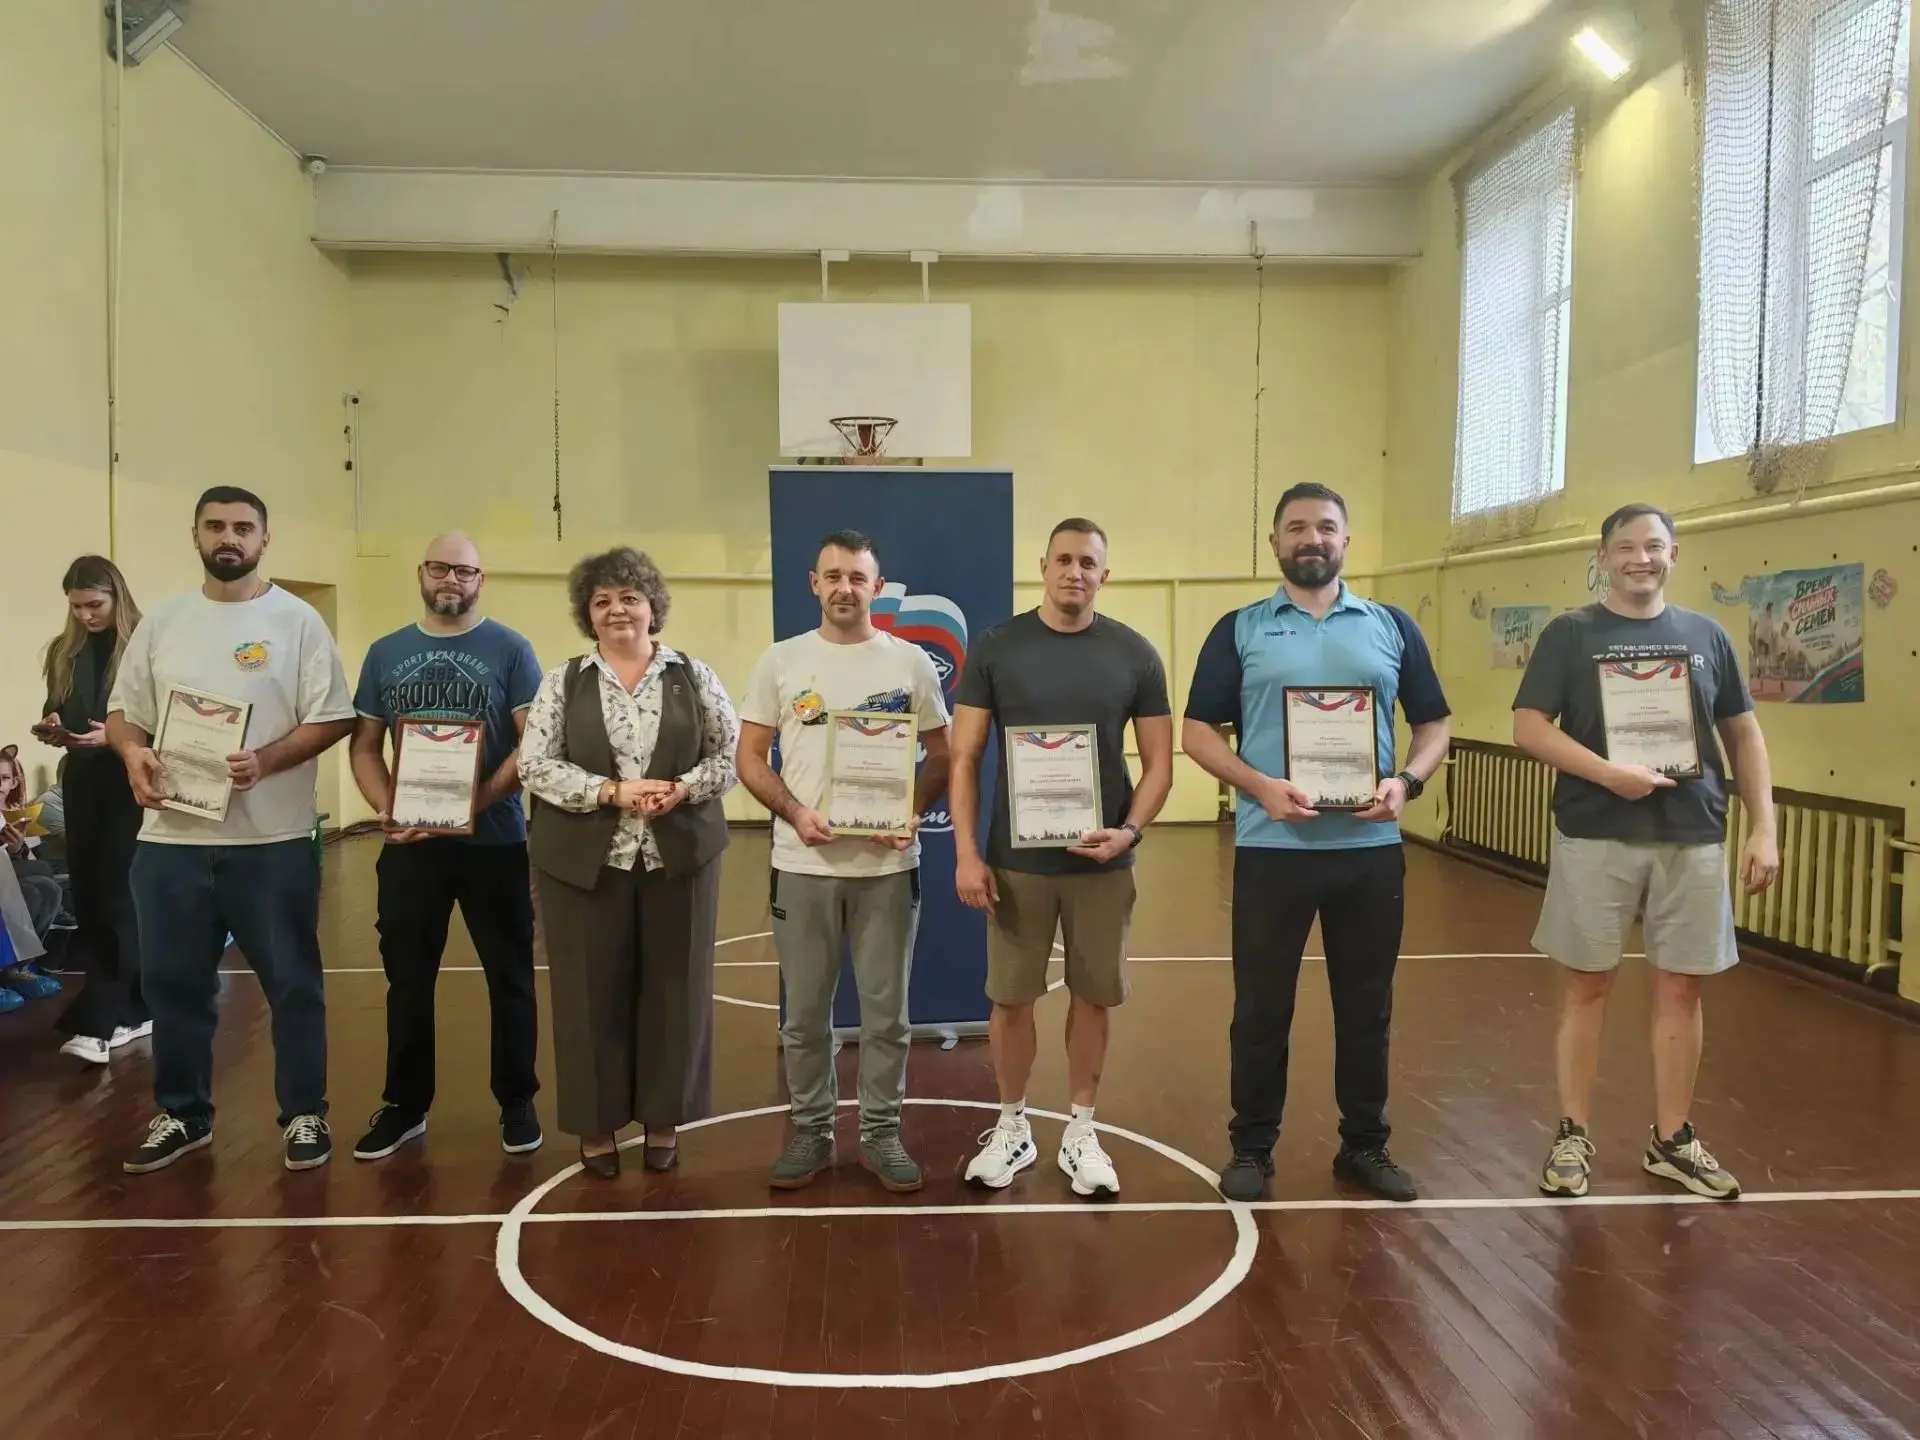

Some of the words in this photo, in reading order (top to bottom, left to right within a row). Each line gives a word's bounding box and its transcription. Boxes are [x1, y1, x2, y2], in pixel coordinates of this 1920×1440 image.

[1608, 643, 1662, 652] ESTABLISHED
[1663, 643, 1689, 652] SINCE
[392, 653, 423, 677] SPORT
[456, 652, 490, 675] BRAND
[388, 681, 492, 714] BROOKLYN
